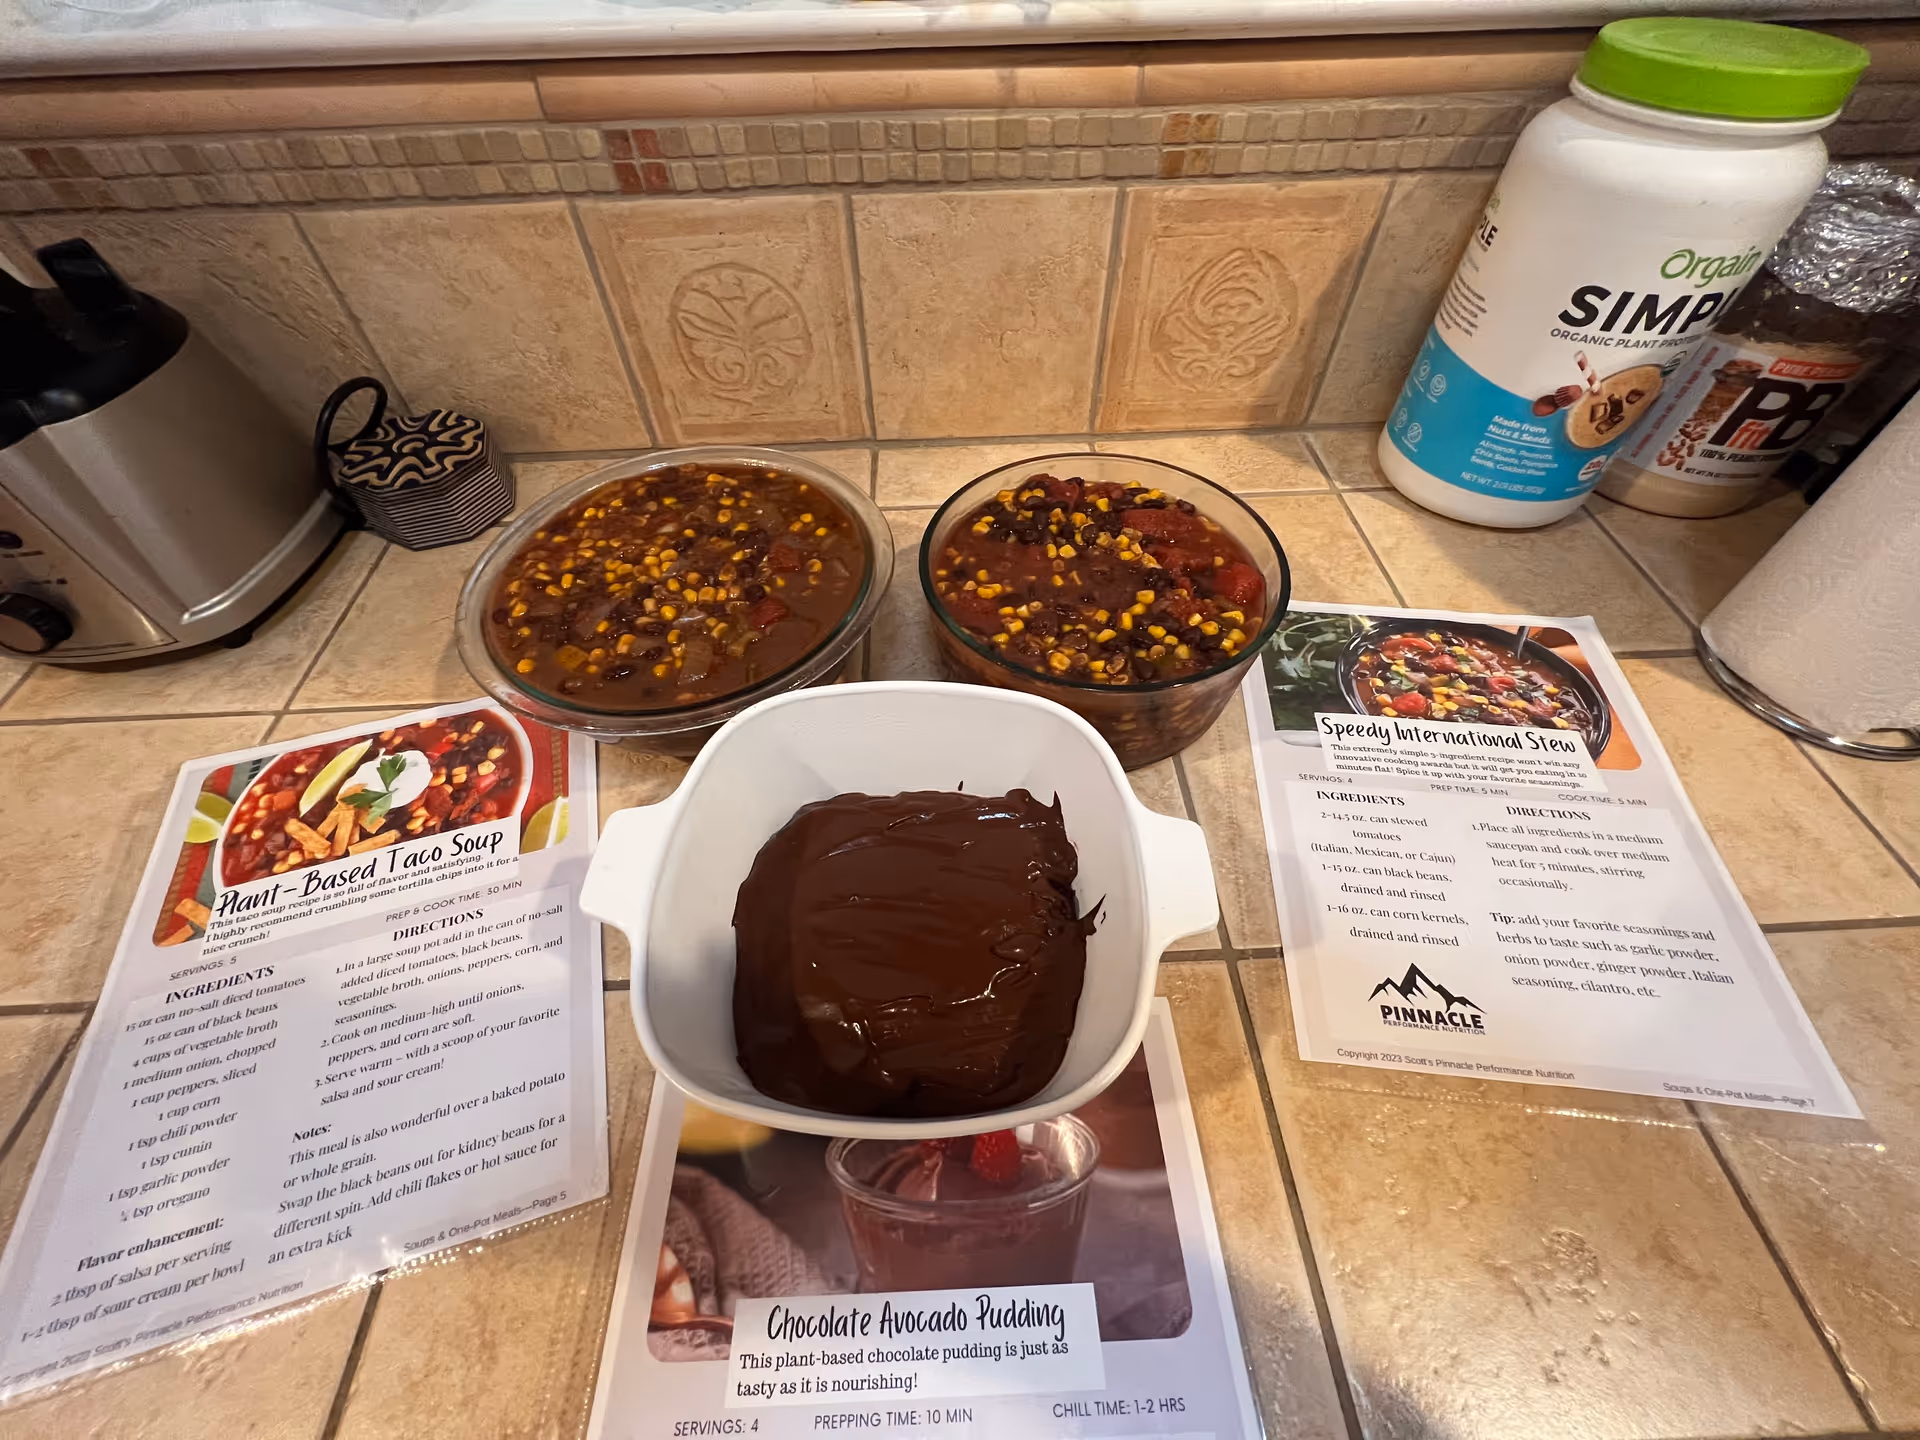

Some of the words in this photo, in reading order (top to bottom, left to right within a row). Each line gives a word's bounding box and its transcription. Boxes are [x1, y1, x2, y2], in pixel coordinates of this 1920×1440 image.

[1660, 246, 1762, 288] Orgain
[1550, 328, 1615, 347] ORGANIC
[1615, 338, 1659, 349] PLANT
[1486, 424, 1511, 437] Nuts
[1492, 415, 1521, 428] Made
[1521, 423, 1547, 434] from
[1321, 716, 1391, 745] Speedy
[1393, 721, 1523, 750] International
[1524, 731, 1576, 753] Stew
[1330, 743, 1352, 751] This
[1352, 746, 1398, 756] extremely
[1399, 748, 1430, 758] simple
[1487, 756, 1516, 765] recipe
[1543, 759, 1562, 767] win
[1562, 762, 1580, 770] any
[1316, 790, 1405, 806] INGREDIENTS
[1429, 783, 1453, 792] PREP
[1481, 787, 1488, 795] 5
[1489, 788, 1509, 796] MIN
[1351, 814, 1368, 822] oz.
[1369, 816, 1389, 824] can
[1390, 816, 1428, 828] stewed
[1505, 806, 1592, 821] DIRECTIONS
[1352, 829, 1402, 842] tomatoes
[1510, 824, 1525, 834] all
[1525, 825, 1591, 839] ingredients
[1591, 830, 1605, 841] in
[1615, 833, 1664, 845] medium
[1485, 841, 1539, 853] saucepan
[1540, 844, 1563, 854] and
[1563, 846, 1593, 857] cook
[1593, 849, 1619, 859] over
[1621, 851, 1671, 863] medium
[216, 857, 378, 918] Plant-Based
[387, 846, 442, 874] Taco
[449, 830, 505, 858] Soup
[209, 918, 234, 930] This
[235, 912, 260, 924] taco
[260, 904, 286, 917] soup
[287, 896, 321, 910] recipe
[322, 893, 332, 902] is
[333, 890, 346, 898] so
[346, 882, 365, 895] full
[366, 879, 378, 889] of
[378, 872, 410, 886] flavor
[410, 866, 431, 878] and
[431, 854, 484, 873] satisfying.
[385, 909, 411, 923] PREP
[412, 906, 420, 916] &
[422, 897, 456, 913] COOK
[502, 879, 523, 892] MIN
[1340, 882, 1384, 896] drained
[1385, 887, 1408, 898] and
[1409, 889, 1447, 902] rinsed
[393, 908, 484, 942] DIRECTIONS
[1351, 907, 1368, 916] oz.
[1369, 908, 1391, 918] can
[1392, 911, 1420, 921] corn
[1488, 911, 1516, 926] Tip:
[1517, 914, 1541, 926] add
[1541, 918, 1570, 929] your
[1572, 918, 1621, 932] favorite
[1622, 924, 1690, 940] seasonings
[1690, 930, 1716, 942] and
[165, 965, 275, 1004] INGREDIENTS
[154, 1012, 176, 1024] can
[178, 998, 220, 1018] no-salt
[222, 988, 254, 1006] diced
[255, 977, 306, 997] tomatoes
[1379, 1004, 1485, 1030] PINNACLE
[1382, 1019, 1440, 1032] PERFORMANCE
[1441, 1025, 1486, 1036] NUTRITION
[1336, 1047, 1379, 1062] Copyright
[1379, 1052, 1403, 1063] 2023
[1435, 1058, 1474, 1071] Pinnacle
[1475, 1062, 1534, 1077] Performance
[1535, 1068, 1576, 1080] Nutrition
[166, 1105, 190, 1119] cup
[192, 1096, 221, 1112] corn
[290, 1148, 315, 1165] This
[318, 1136, 348, 1157] meal
[351, 1134, 361, 1147] is
[363, 1127, 388, 1143] also
[391, 1104, 451, 1133] wonderful
[453, 1097, 480, 1113] over
[481, 1095, 489, 1105] a
[491, 1081, 526, 1102] baked
[529, 1072, 566, 1092] potato
[292, 1123, 332, 1144] Notes:
[282, 1176, 299, 1189] or
[301, 1163, 339, 1183] whole
[340, 1152, 377, 1174] grain.
[267, 1250, 285, 1265] an
[288, 1238, 323, 1258] extra
[326, 1225, 353, 1246] kick
[77, 1249, 126, 1272] Flavor
[767, 1304, 872, 1341] Chocolate
[878, 1300, 968, 1340] Avocado
[975, 1293, 1066, 1342] Pudding
[739, 1352, 773, 1370] This
[774, 1348, 864, 1372] plant-based
[867, 1345, 940, 1364] chocolate
[942, 1342, 1002, 1364] pudding
[1004, 1340, 1018, 1357] is
[1019, 1340, 1049, 1361] just
[1051, 1342, 1069, 1355] as
[736, 1380, 778, 1400] tasty
[779, 1381, 797, 1395] as
[800, 1376, 812, 1394] it
[815, 1376, 828, 1393] is
[831, 1372, 918, 1394] nourishing!
[814, 1411, 882, 1431] PREPPING
[885, 1410, 922, 1427] TIME:
[926, 1408, 941, 1425] 10
[946, 1407, 973, 1424] MIN
[1052, 1401, 1092, 1418] CHILL
[1093, 1399, 1132, 1416] TIME:
[1133, 1398, 1156, 1415] 1-2
[1158, 1397, 1186, 1413] HRS
[673, 1418, 746, 1437] SERVINGS:
[750, 1418, 759, 1433] 4
